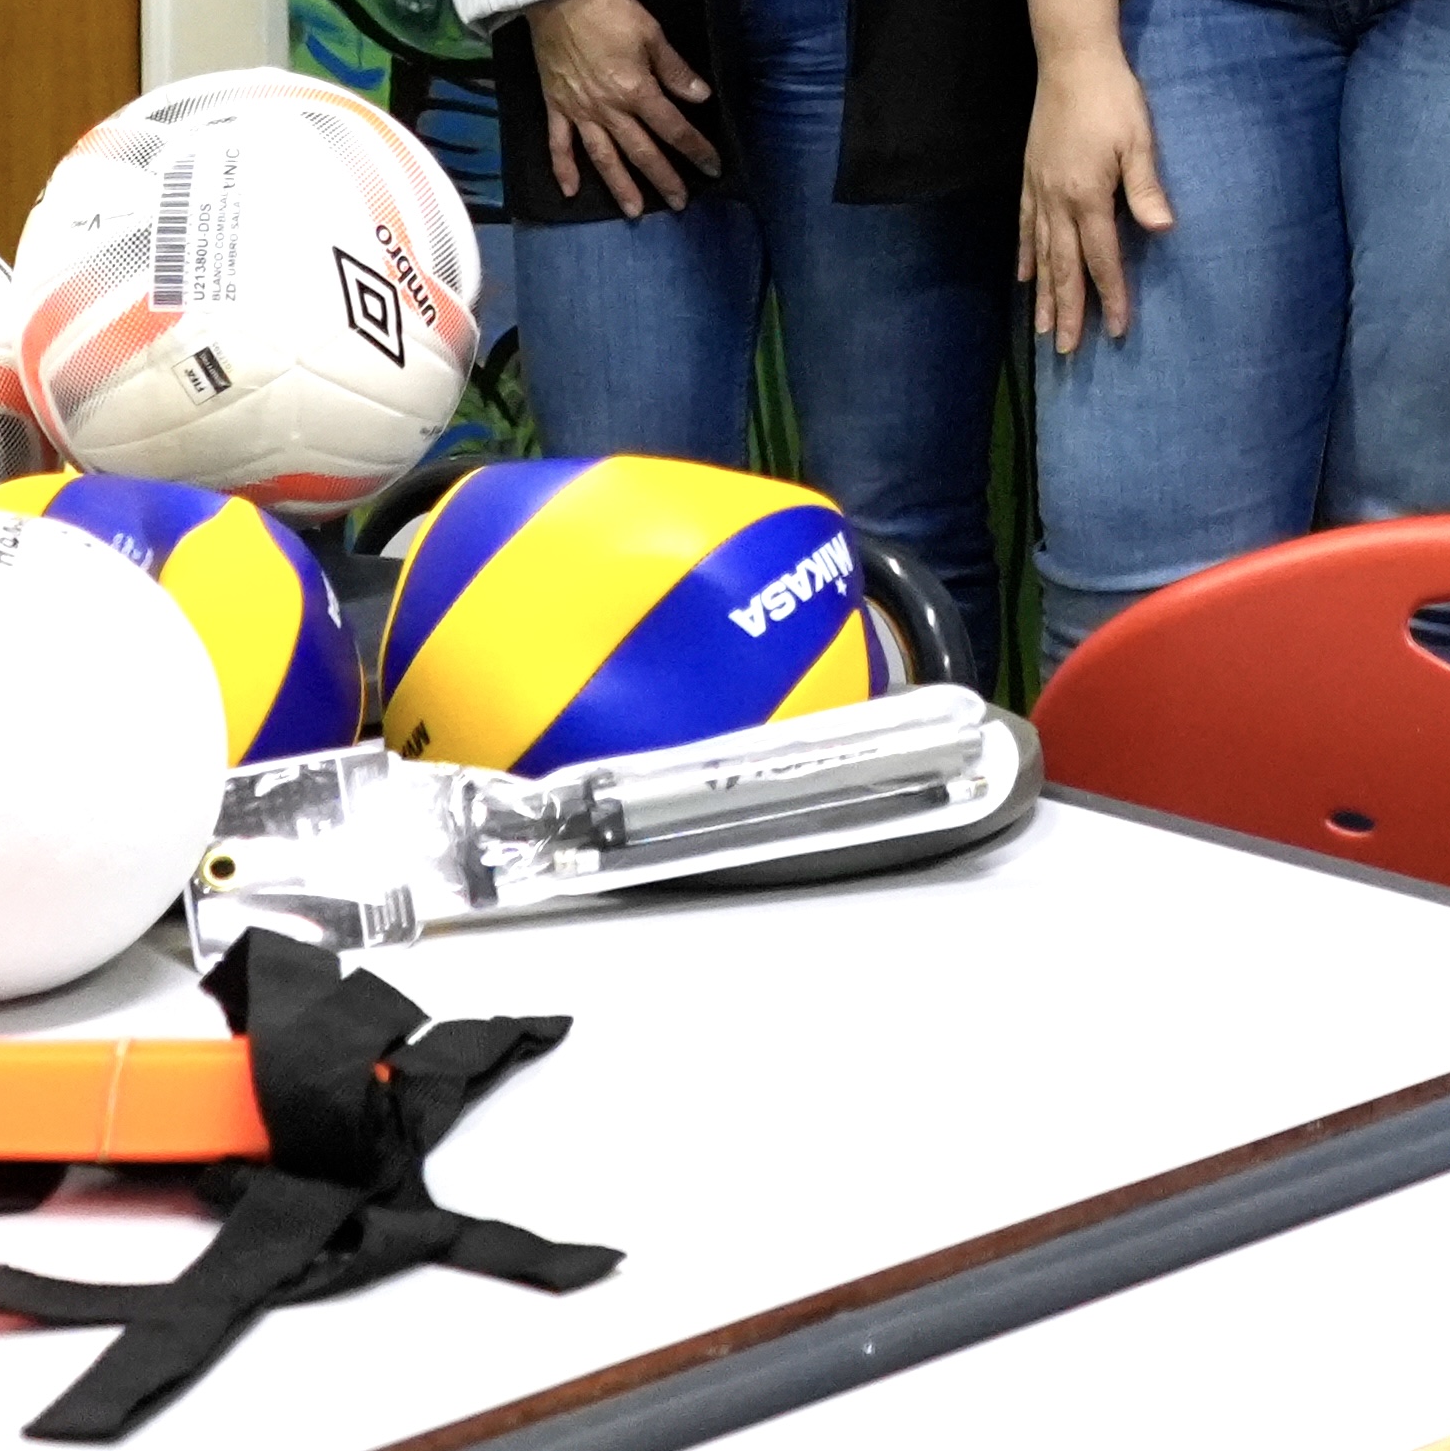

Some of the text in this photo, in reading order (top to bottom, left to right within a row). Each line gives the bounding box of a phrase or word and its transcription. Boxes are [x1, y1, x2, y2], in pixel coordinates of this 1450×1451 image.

[193, 202, 212, 301] U21380U-DDS
[212, 252, 224, 301] BLANCO
[227, 233, 239, 278] UMBRO
[375, 224, 437, 328] umbro
[728, 530, 854, 638] MIKASA
